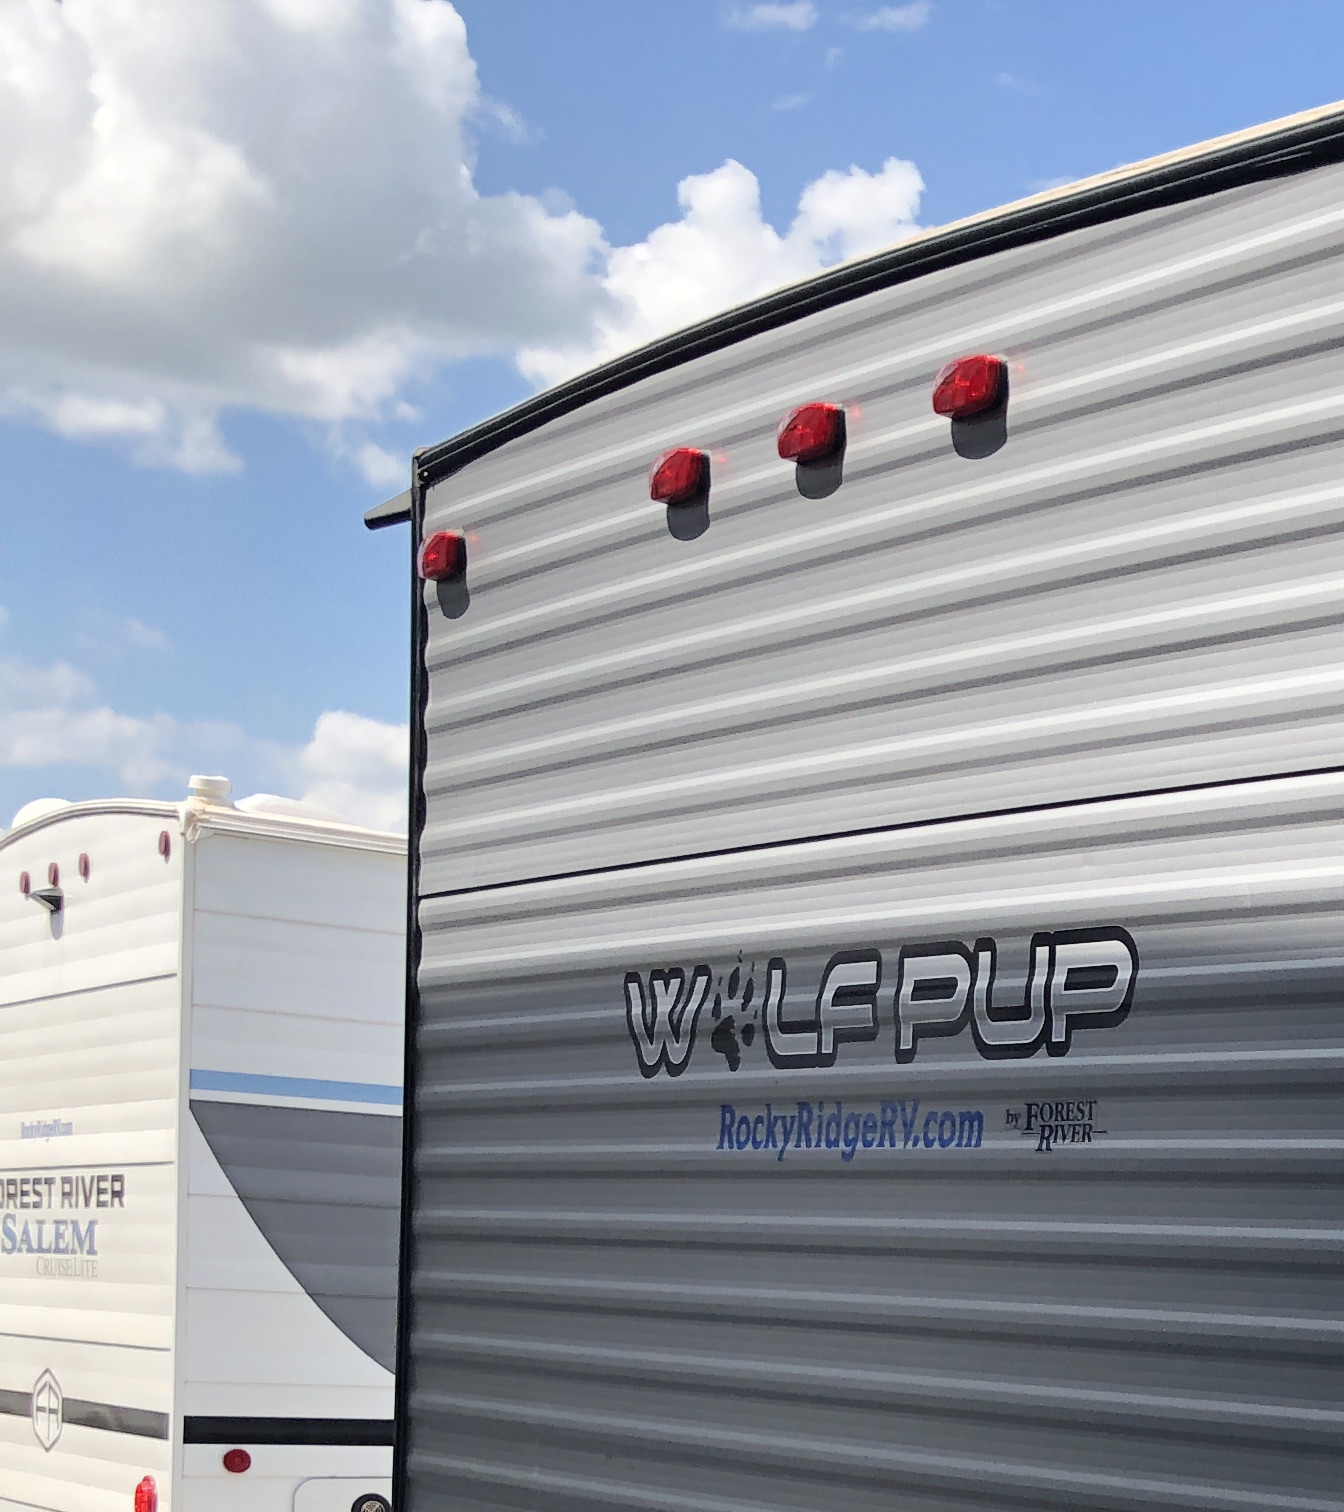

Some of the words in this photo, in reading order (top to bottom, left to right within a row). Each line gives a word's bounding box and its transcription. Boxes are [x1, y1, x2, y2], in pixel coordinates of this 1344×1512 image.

[894, 925, 1139, 1064] PUP
[716, 1100, 984, 1162] RockyRidgeRV.com
[1005, 1107, 1021, 1130] by
[1024, 1100, 1097, 1131] FOREST
[1034, 1123, 1093, 1152] RIVER
[61, 1173, 126, 1209] RIVER
[1, 1212, 99, 1256] SALEM
